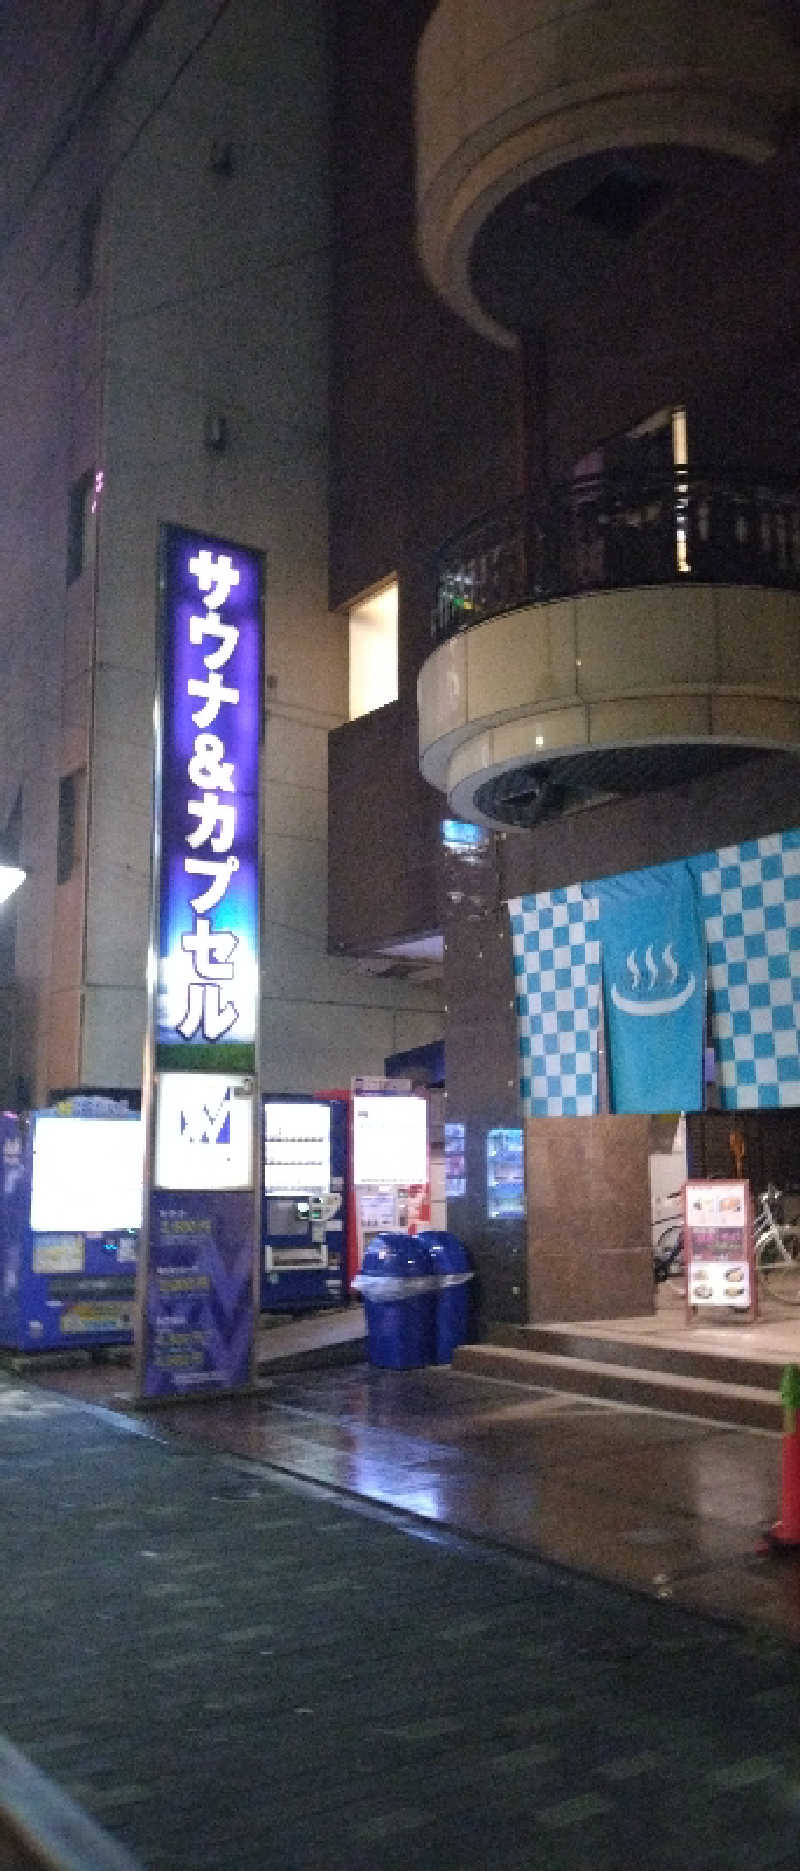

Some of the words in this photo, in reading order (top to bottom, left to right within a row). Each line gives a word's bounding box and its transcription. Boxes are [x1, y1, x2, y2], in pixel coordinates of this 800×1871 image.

[177, 550, 240, 1041] サウナ&カプセル
